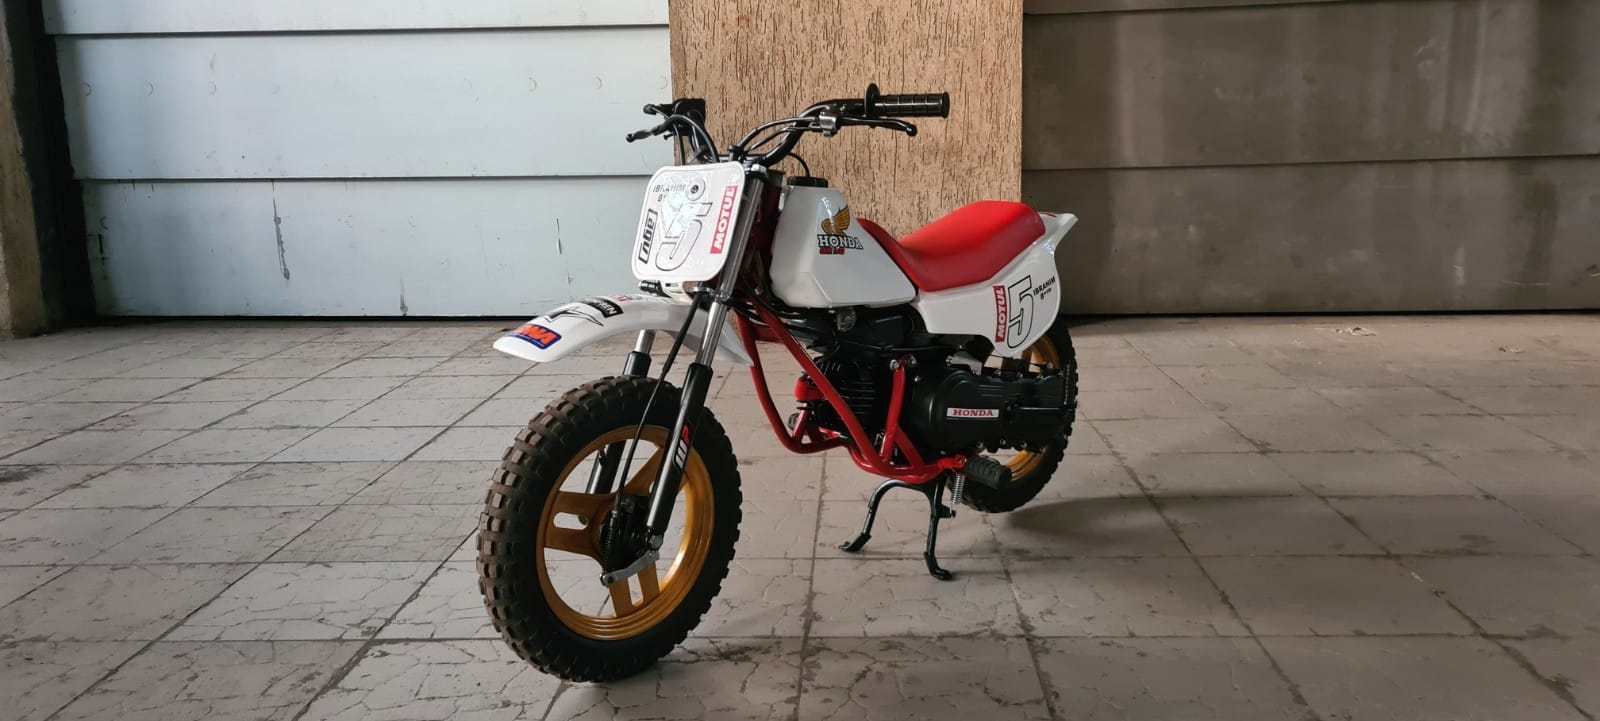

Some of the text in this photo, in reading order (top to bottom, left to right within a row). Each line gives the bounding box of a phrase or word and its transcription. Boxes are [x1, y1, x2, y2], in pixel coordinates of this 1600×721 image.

[655, 202, 713, 271] 5
[713, 186, 736, 250] MOTUL
[817, 234, 864, 250] HONDA
[1007, 275, 1034, 349] 5
[1033, 276, 1056, 297] IBRAHIM
[995, 287, 1006, 340] MOTUL
[953, 409, 994, 417] HONDA
